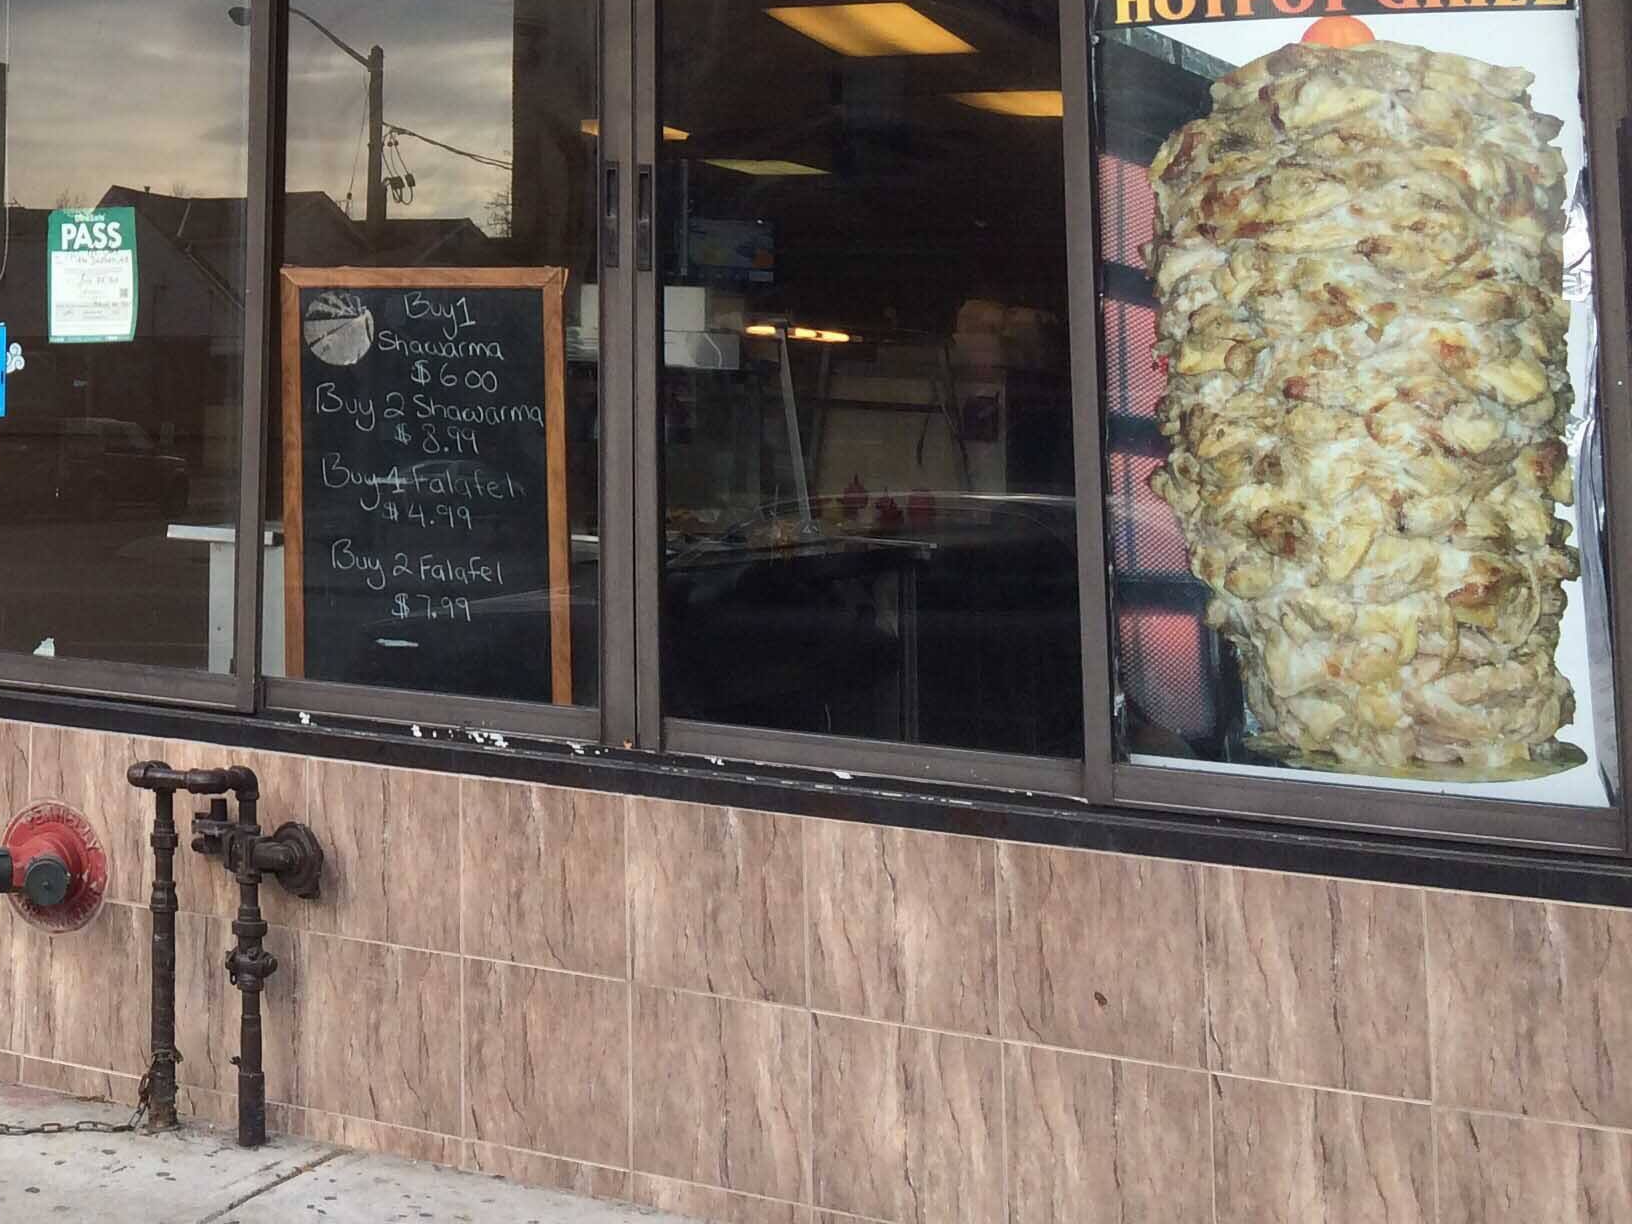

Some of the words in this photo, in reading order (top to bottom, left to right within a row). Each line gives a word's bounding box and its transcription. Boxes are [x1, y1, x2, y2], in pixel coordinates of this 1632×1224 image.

[61, 221, 122, 250] PASS
[403, 291, 458, 339] Buy
[378, 330, 505, 360] Shawarma
[316, 382, 376, 431] Buy
[383, 392, 405, 418] 2
[413, 394, 545, 427] Shawarma
[322, 452, 381, 511] Buy
[412, 464, 516, 498] Falafel
[331, 539, 386, 590] Buy
[393, 552, 414, 576] 2
[420, 554, 505, 585] Falafel
